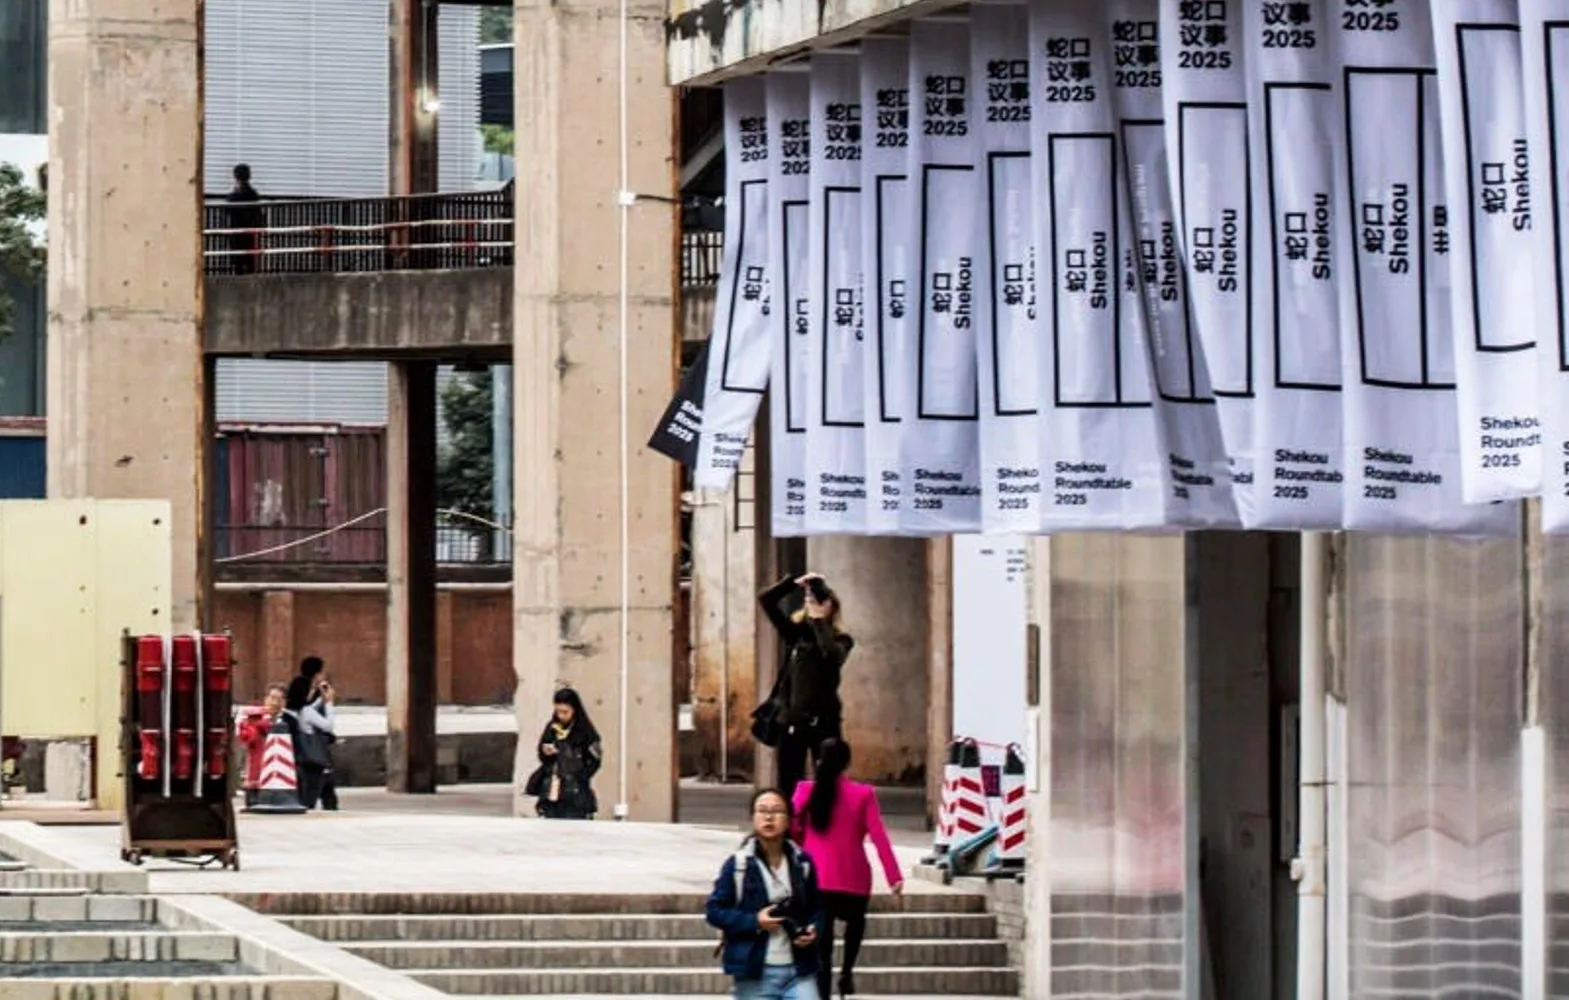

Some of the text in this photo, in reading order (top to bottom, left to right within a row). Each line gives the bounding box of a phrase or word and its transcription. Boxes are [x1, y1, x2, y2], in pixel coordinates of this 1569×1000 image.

[1178, 0, 1226, 22] 蛇口
[1262, 2, 1312, 26] 议事
[1112, 20, 1157, 42] 蛇口
[1342, 12, 1400, 31] 2025
[1180, 24, 1227, 47] 议事
[1262, 30, 1316, 48] 2025
[1046, 38, 1091, 58] 蛇口
[1114, 45, 1160, 67] 议事
[987, 60, 1030, 80] 蛇口
[1178, 51, 1232, 69] 2025
[1048, 61, 1091, 82] 议事
[1115, 70, 1162, 88] 2025
[926, 74, 965, 94] 蛇口
[988, 82, 1030, 102] 议事
[1046, 86, 1096, 102] 2025
[926, 98, 964, 117] 议事
[986, 106, 1032, 122] 2025
[923, 120, 968, 136] 2025
[1481, 162, 1507, 214] 蛇口
[1511, 138, 1531, 232] Shekou
[1284, 212, 1308, 260] 蛇口
[1312, 193, 1331, 280] Shekou
[1362, 204, 1385, 254] 蛇口
[1388, 184, 1409, 274] Shekou
[1194, 228, 1216, 274] 蛇口
[1218, 209, 1237, 292] Shekou
[1064, 250, 1088, 292] 蛇口
[1090, 232, 1108, 310] Shekou
[1160, 222, 1178, 302] Shekou
[743, 266, 764, 301] 蛇口
[932, 272, 952, 313] 蛇口
[954, 256, 972, 330] Shekou
[1004, 264, 1024, 306] 蛇口
[835, 288, 854, 326] 蛇口
[1274, 449, 1329, 464] Shekou
[1364, 447, 1414, 464] Shekou
[1482, 454, 1522, 468] 2025
[914, 468, 963, 482] Shekou
[1054, 461, 1107, 474] Shekou
[1364, 466, 1442, 484] Roundtable
[1054, 477, 1132, 490] Roundtable
[1273, 485, 1309, 499] 2025
[1364, 485, 1397, 500] 2025
[914, 498, 944, 510] 2025
[998, 498, 1029, 510] 2025
[1054, 494, 1087, 506] 2025
